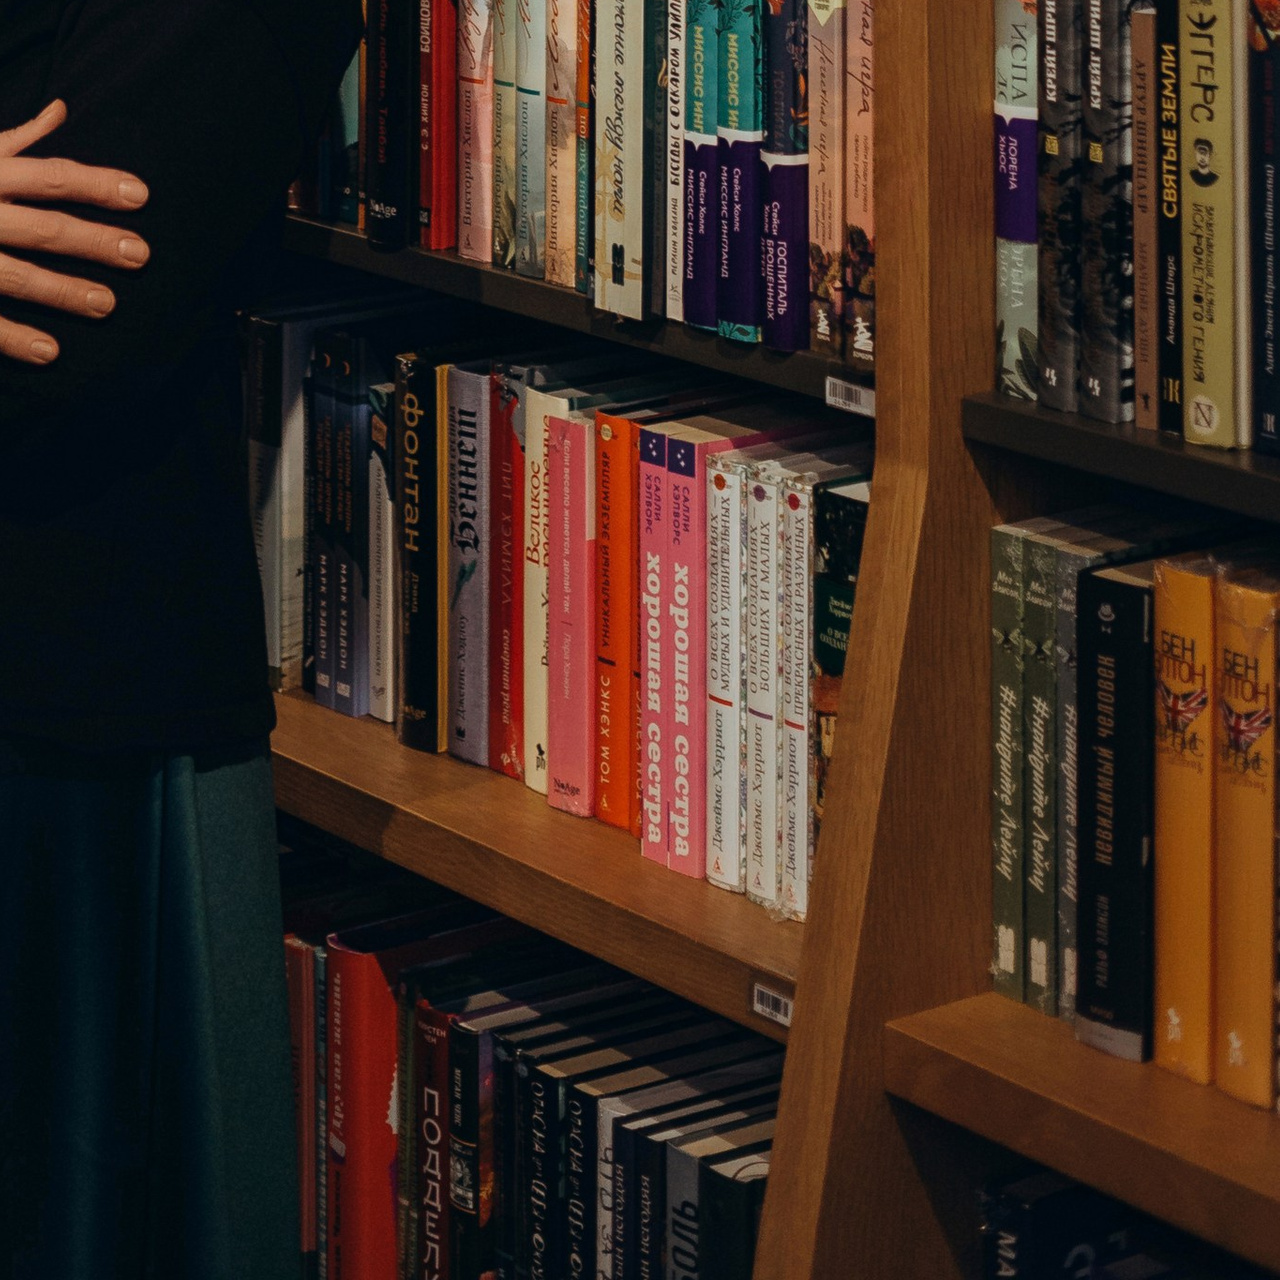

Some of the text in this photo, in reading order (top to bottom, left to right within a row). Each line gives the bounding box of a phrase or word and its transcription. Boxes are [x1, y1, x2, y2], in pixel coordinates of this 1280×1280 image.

[605, 71, 625, 151] между
[693, 25, 704, 93] МИССИС
[727, 32, 739, 106] МИССИС
[849, 55, 875, 116] игра
[1046, 41, 1058, 103] КРЕЙГ
[1089, 49, 1102, 110] КРЕЙГ
[1187, 13, 1219, 124] ЭГГЕРС
[462, 90, 474, 226] Виктория Хислоп
[548, 110, 560, 252] Виктория Хислоп
[998, 135, 1007, 174] ХЬЮС
[1008, 135, 1018, 191] ЛОРЕНА
[1160, 42, 1178, 219] СВЯТЫЕ ЗЕМЛИ
[577, 115, 588, 258] Виктория Хислоп
[613, 156, 625, 214] нами
[686, 169, 695, 280] МИССИС ИНГЛАНД
[698, 170, 707, 235] Стейси Холлс
[720, 166, 729, 278] МИССИС ИНГЛАНД
[732, 167, 741, 233] Стейси Холлс
[771, 201, 780, 236] Стейси
[765, 238, 776, 321] БРОШЕННЫХ
[776, 241, 788, 316] ГОСПИТАЛЬ
[1165, 254, 1177, 345] Аманда Шторс
[1189, 203, 1205, 384] ИСКРОМЕТНОГО ГЕНИЯ
[451, 408, 480, 555] Беннет
[562, 439, 572, 466] Если
[562, 467, 572, 506] весело
[644, 473, 652, 535] ХЭПВОРС
[653, 476, 661, 522] САЛЛИ
[501, 462, 513, 605] ПИТ ХЭМИЛЛ
[525, 460, 541, 566] Великое
[599, 451, 610, 648] УНИКАЛЬНЫЙ ЭКЗЕМПЛЯР
[673, 483, 681, 546] ХЭПВОРС
[682, 486, 690, 533] САЛЛИ
[319, 554, 328, 659] МАРК ХЭДДОН
[339, 562, 348, 670] МАРК ХЭДДОН
[562, 558, 572, 593] делай
[562, 595, 572, 614] так
[710, 514, 719, 681] О ВСЕХ СОЗДАНИЯХ
[720, 497, 730, 692] МУДРЫХ И УДИВИТЕЛЬНЫХ
[749, 525, 758, 694] О ВСЕХ СОЗДАНИЯХ
[760, 521, 771, 692] БОЛЬШИХ И МАЛЫХ
[784, 535, 792, 704] О ВСЕХ СОЗДАНИЯХ
[794, 516, 804, 717] ПРЕКРАСНЫХ И РАЗУМНЫХ
[458, 614, 469, 724] Дженис Хэдлоу
[501, 628, 511, 725] северная река
[643, 551, 661, 844] хорошая сестра
[1161, 630, 1196, 662] БЕН
[600, 675, 611, 784] ТОМ ХЭНКС
[670, 562, 690, 858] хорошая сестра
[712, 709, 723, 853] Джеймс Хэрриот
[753, 723, 764, 867] Джеймс Хэрриот
[787, 733, 798, 879] Джеймс Хэрриот
[995, 684, 1020, 881] #найдите Лейлу
[1028, 695, 1051, 893] #найдите Лейлу
[454, 1067, 463, 1100] МЕГАН
